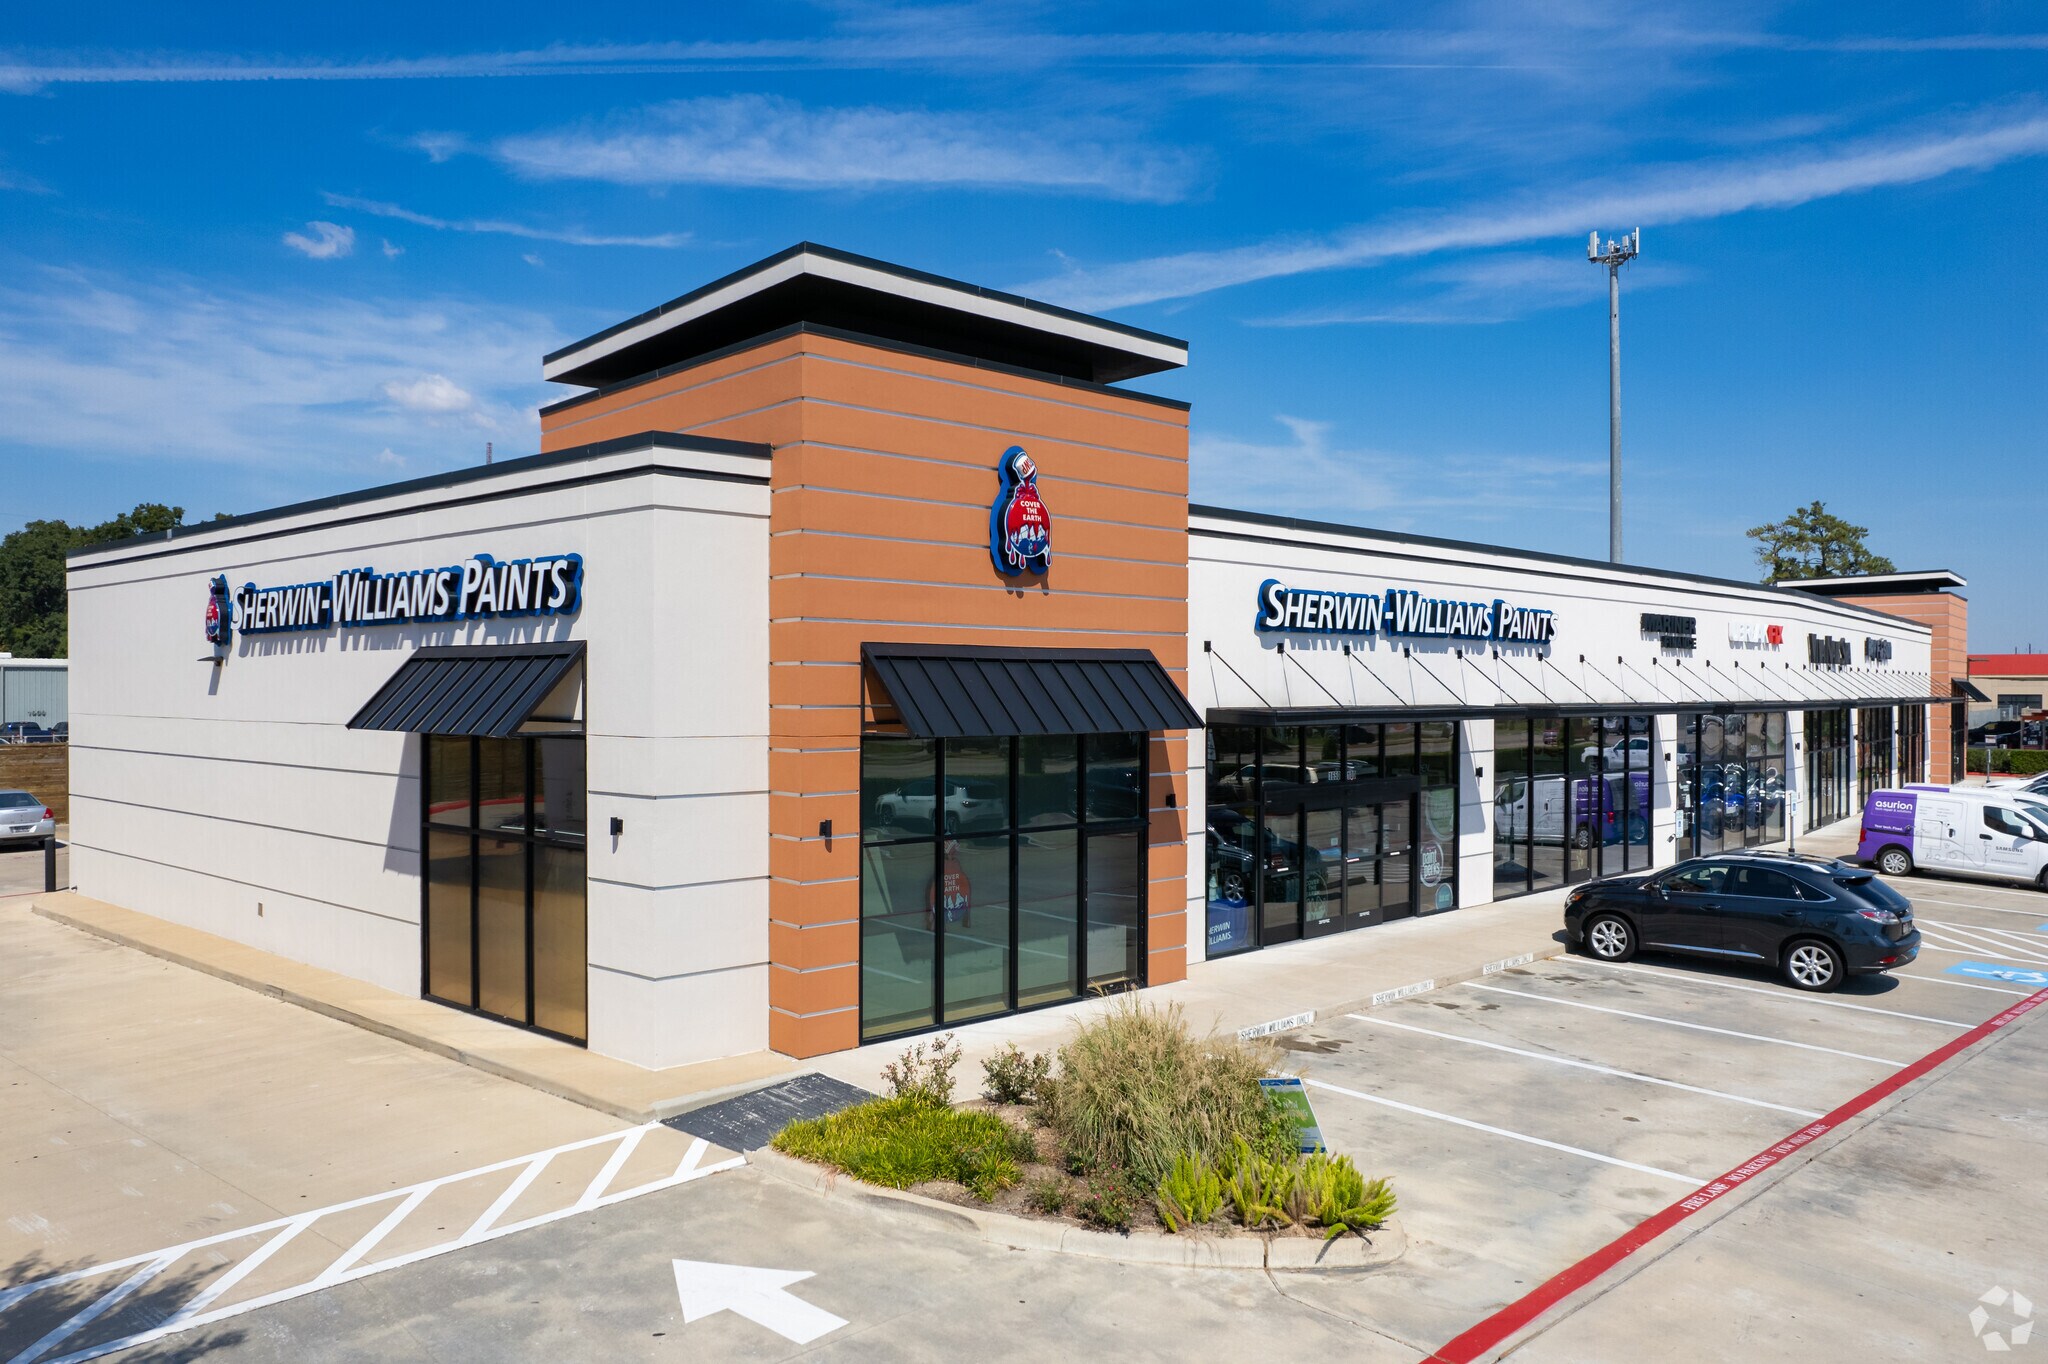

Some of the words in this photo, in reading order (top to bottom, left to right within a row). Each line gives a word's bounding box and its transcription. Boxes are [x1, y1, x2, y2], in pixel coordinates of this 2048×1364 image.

[1020, 500, 1041, 508] COVER
[1026, 507, 1038, 515] THE
[1022, 514, 1042, 522] EARTH
[230, 570, 452, 631] SHERWIN-WILLIAMS
[458, 557, 572, 614] PAINTS
[1264, 583, 1493, 637] SHERWIN-WILLIAMS
[1498, 602, 1560, 642] PAINTS
[1641, 613, 1696, 634] MARINER
[1875, 801, 1913, 811] asurion
[1996, 846, 2024, 854] SAMSUNG
[1680, 1192, 1709, 1210] FIRE
[1700, 1182, 1731, 1199] LANE
[1725, 1170, 1744, 1182] NO
[1739, 1154, 1777, 1175] PARKING
[1771, 1142, 1796, 1154] TOW
[1806, 1124, 1831, 1137] ZONE
